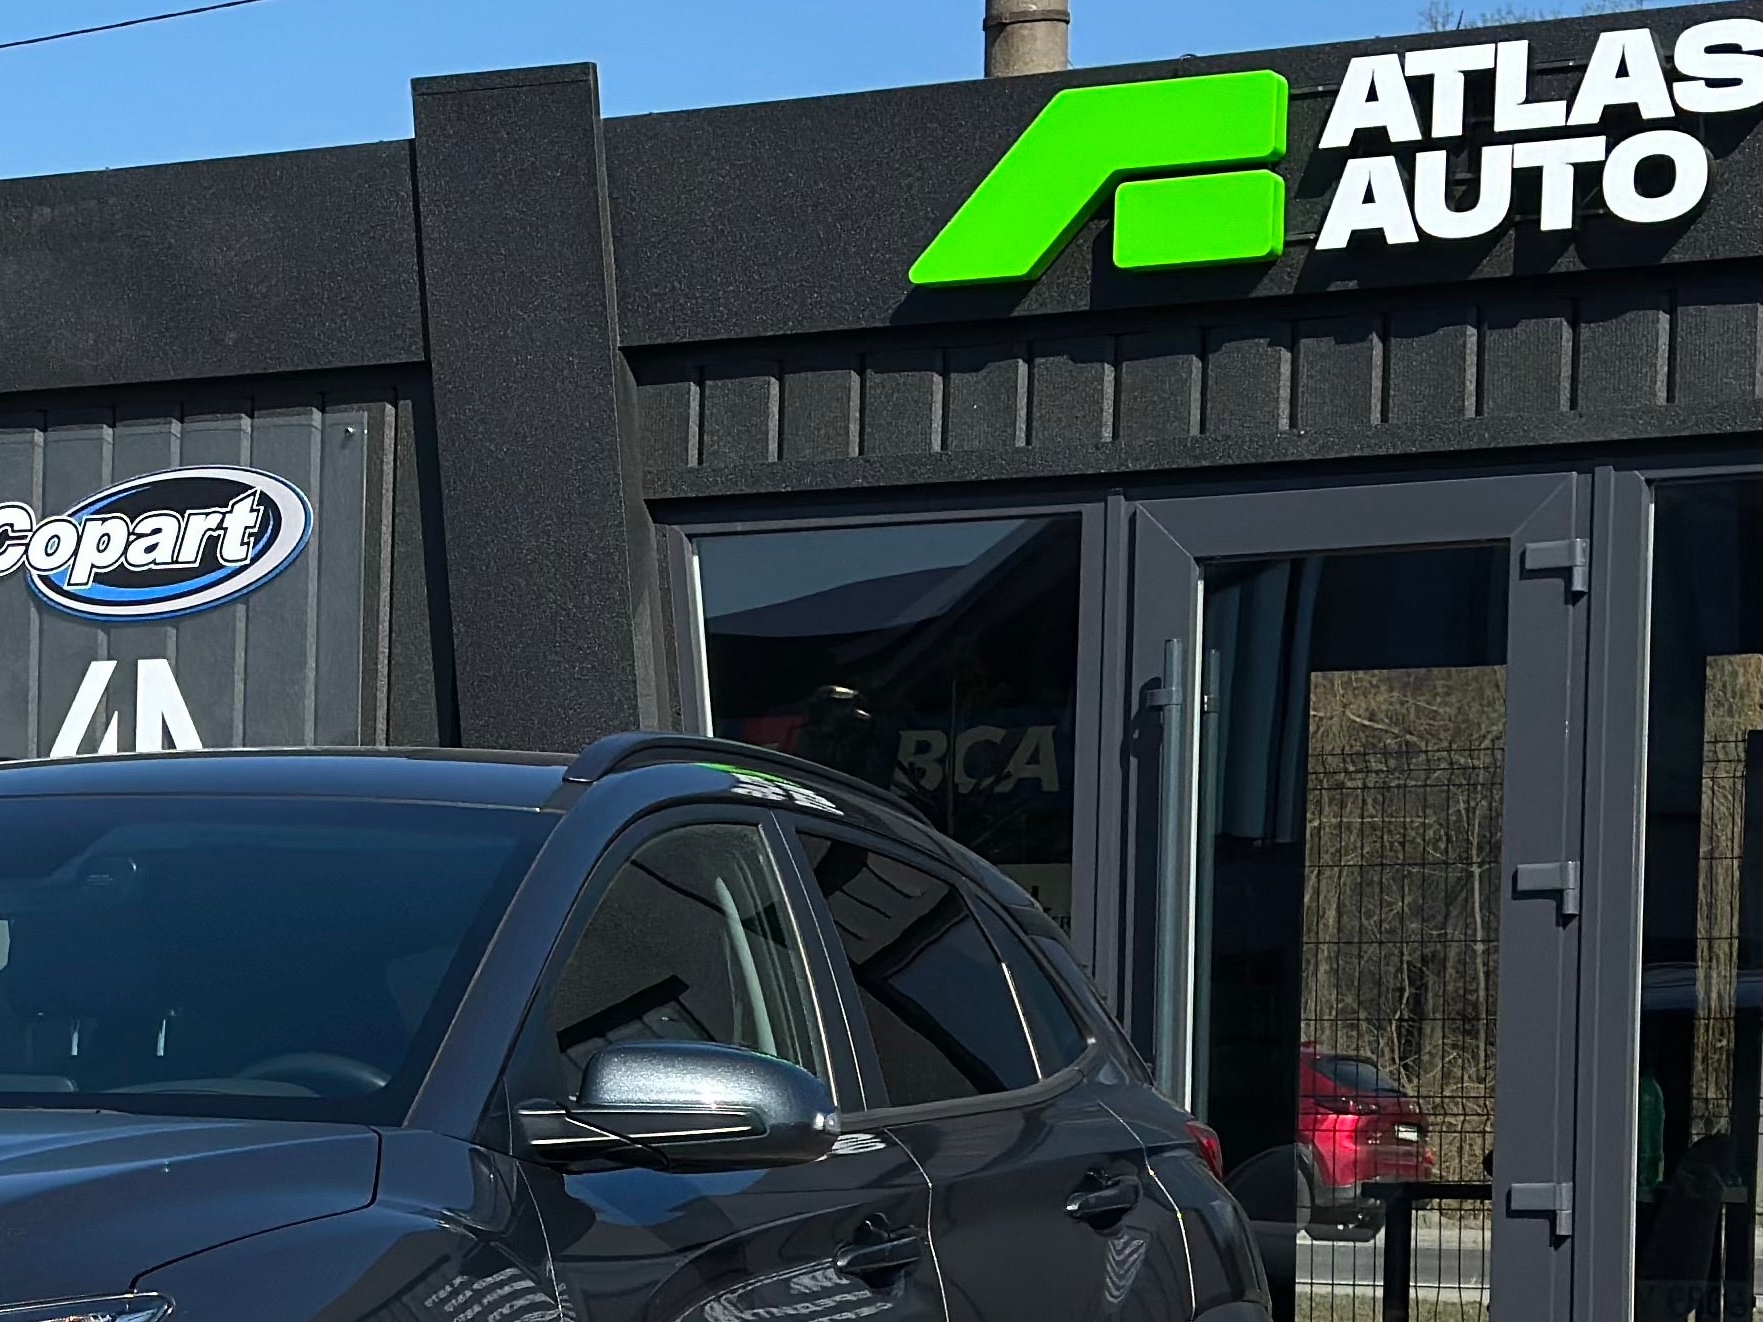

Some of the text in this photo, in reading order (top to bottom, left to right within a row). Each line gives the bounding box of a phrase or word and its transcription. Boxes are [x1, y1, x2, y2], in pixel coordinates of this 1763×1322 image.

[1318, 18, 1763, 150] ATLAS
[1315, 135, 1708, 251] AUTO
[890, 725, 1061, 795] BCA
